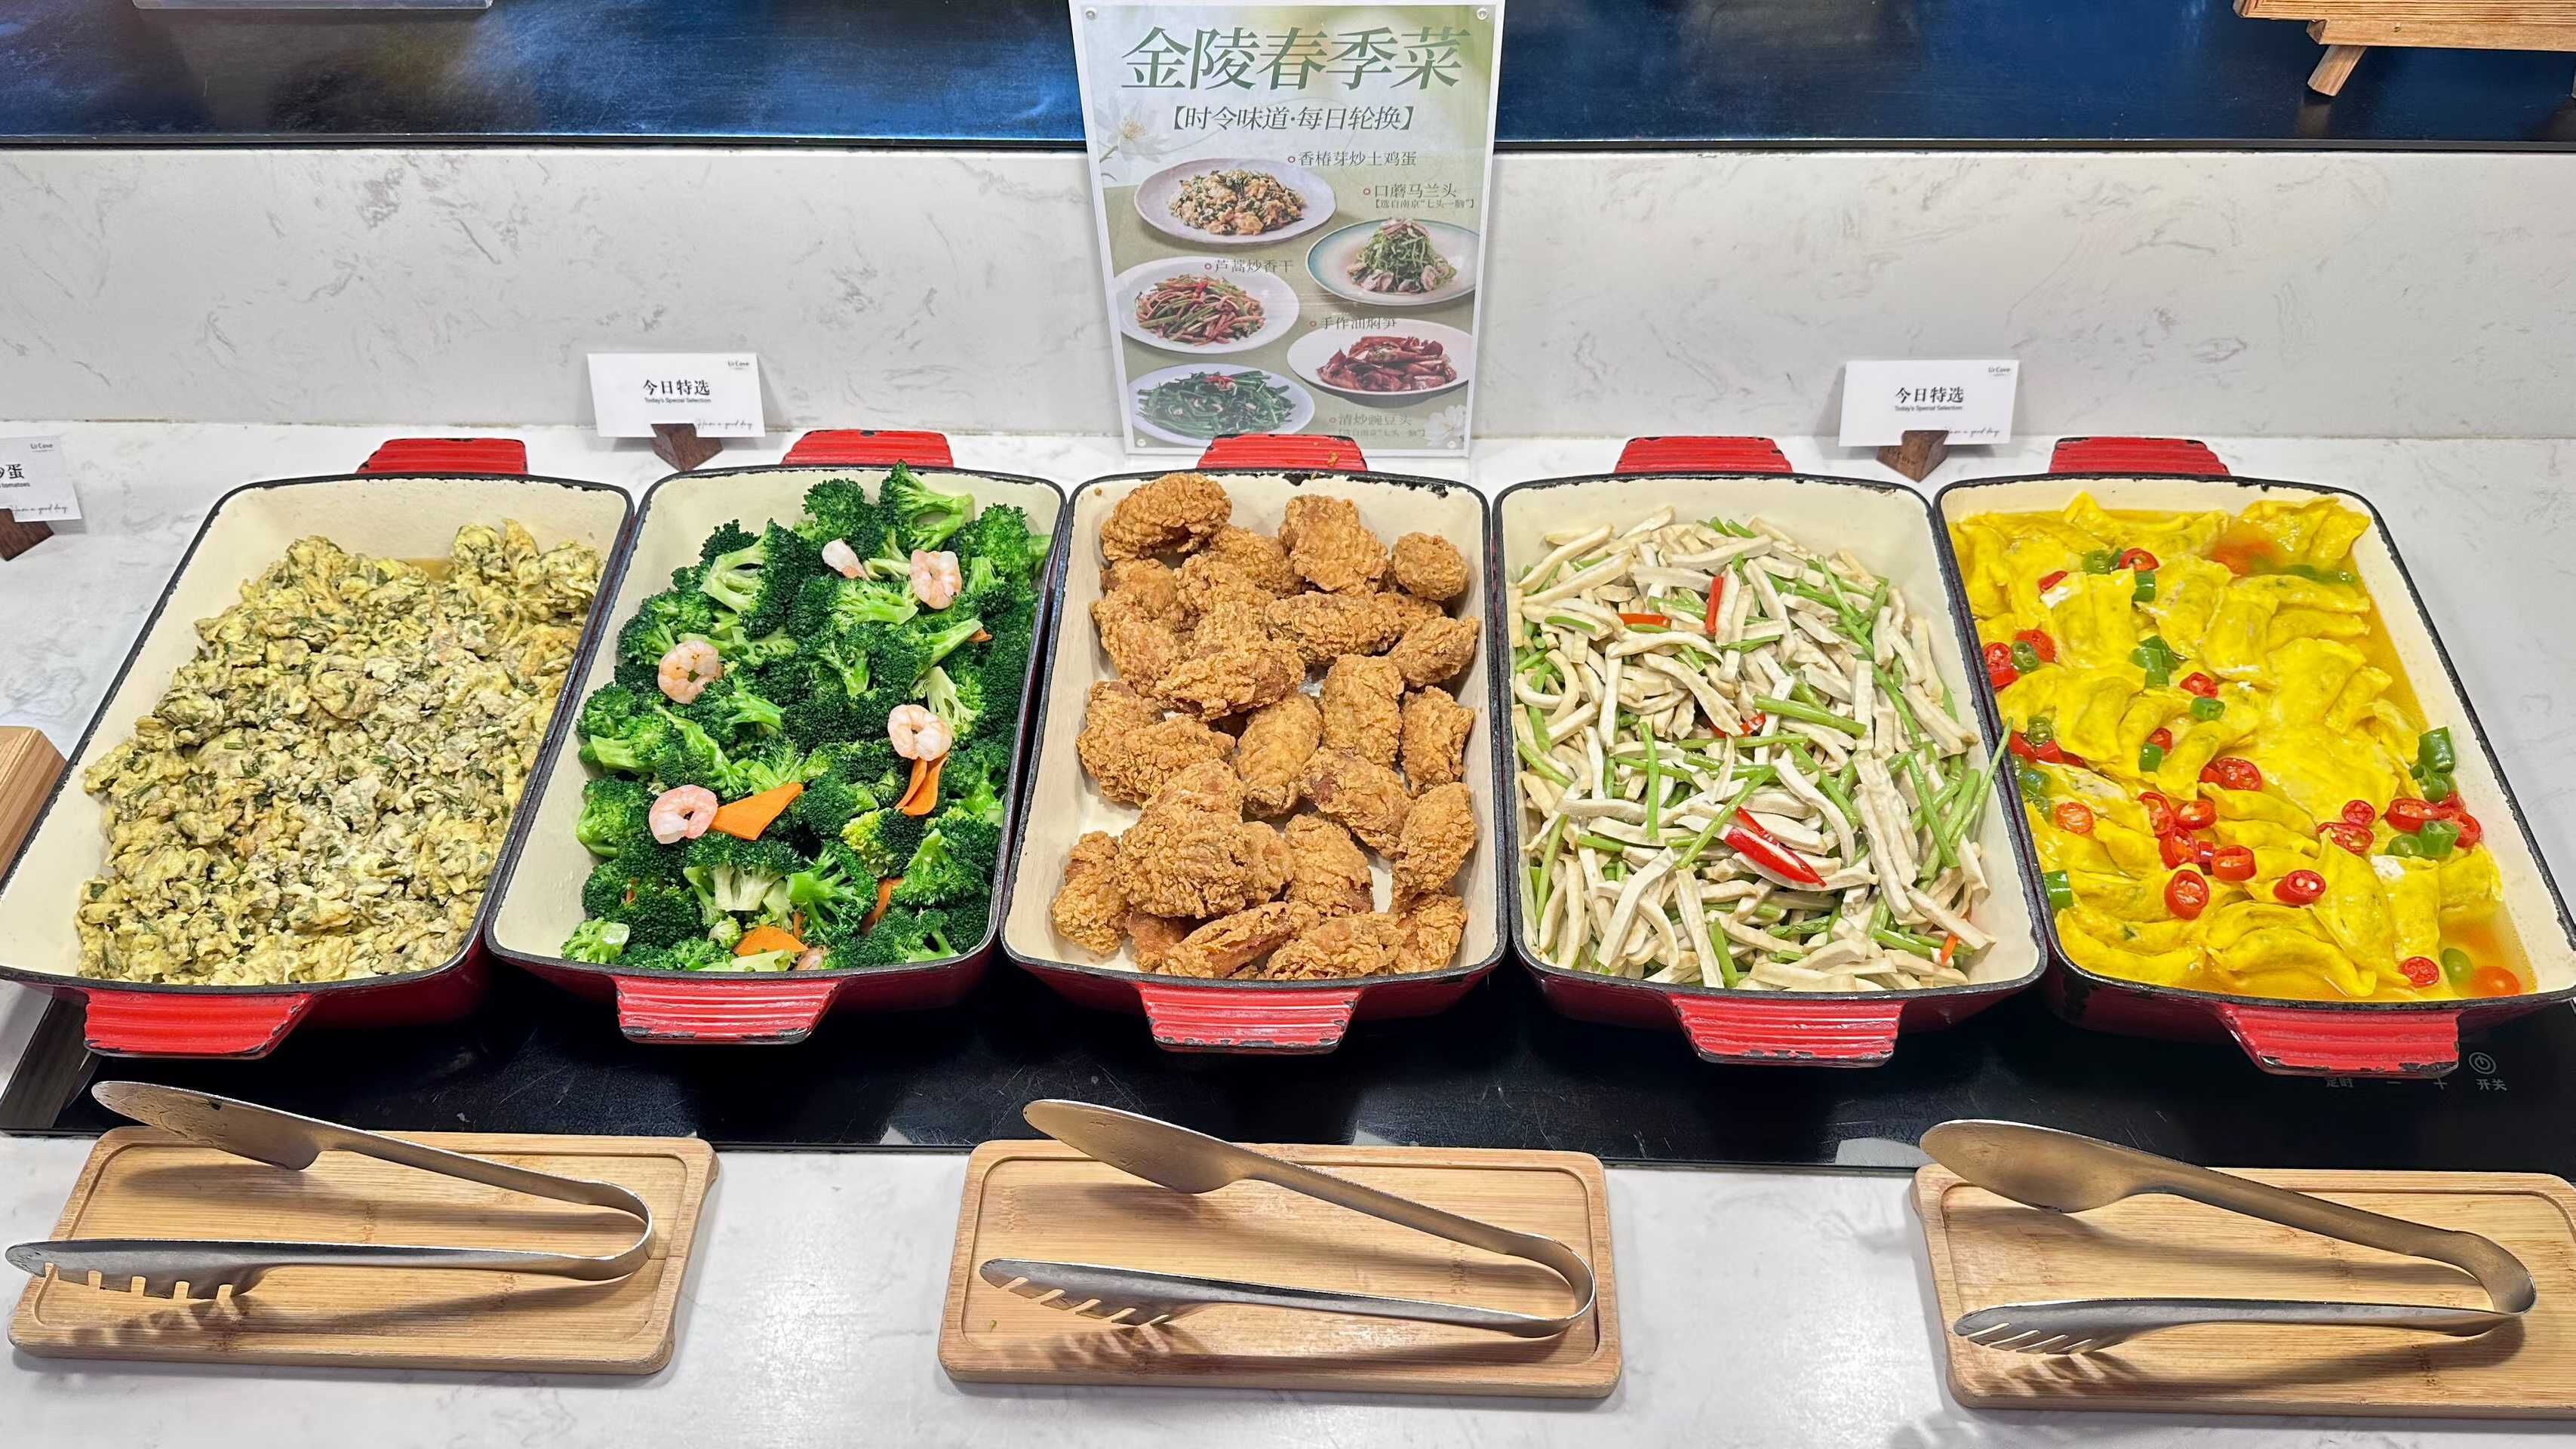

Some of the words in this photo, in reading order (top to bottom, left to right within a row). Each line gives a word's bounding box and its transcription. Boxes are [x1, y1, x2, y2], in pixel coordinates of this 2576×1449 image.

[1120, 26, 1471, 91] 金陵春季菜
[1173, 106, 1416, 131] 【时令味道·每日轮换】
[1299, 150, 1417, 167] 香椿芽炒土鸡蛋
[1213, 259, 1293, 273] 芦蒿炒香干
[1319, 315, 1397, 330] 手作油焖笋
[643, 379, 711, 396] 今日特选
[1895, 386, 1965, 404] 今日特选
[2476, 1078, 2507, 1091] 开关
